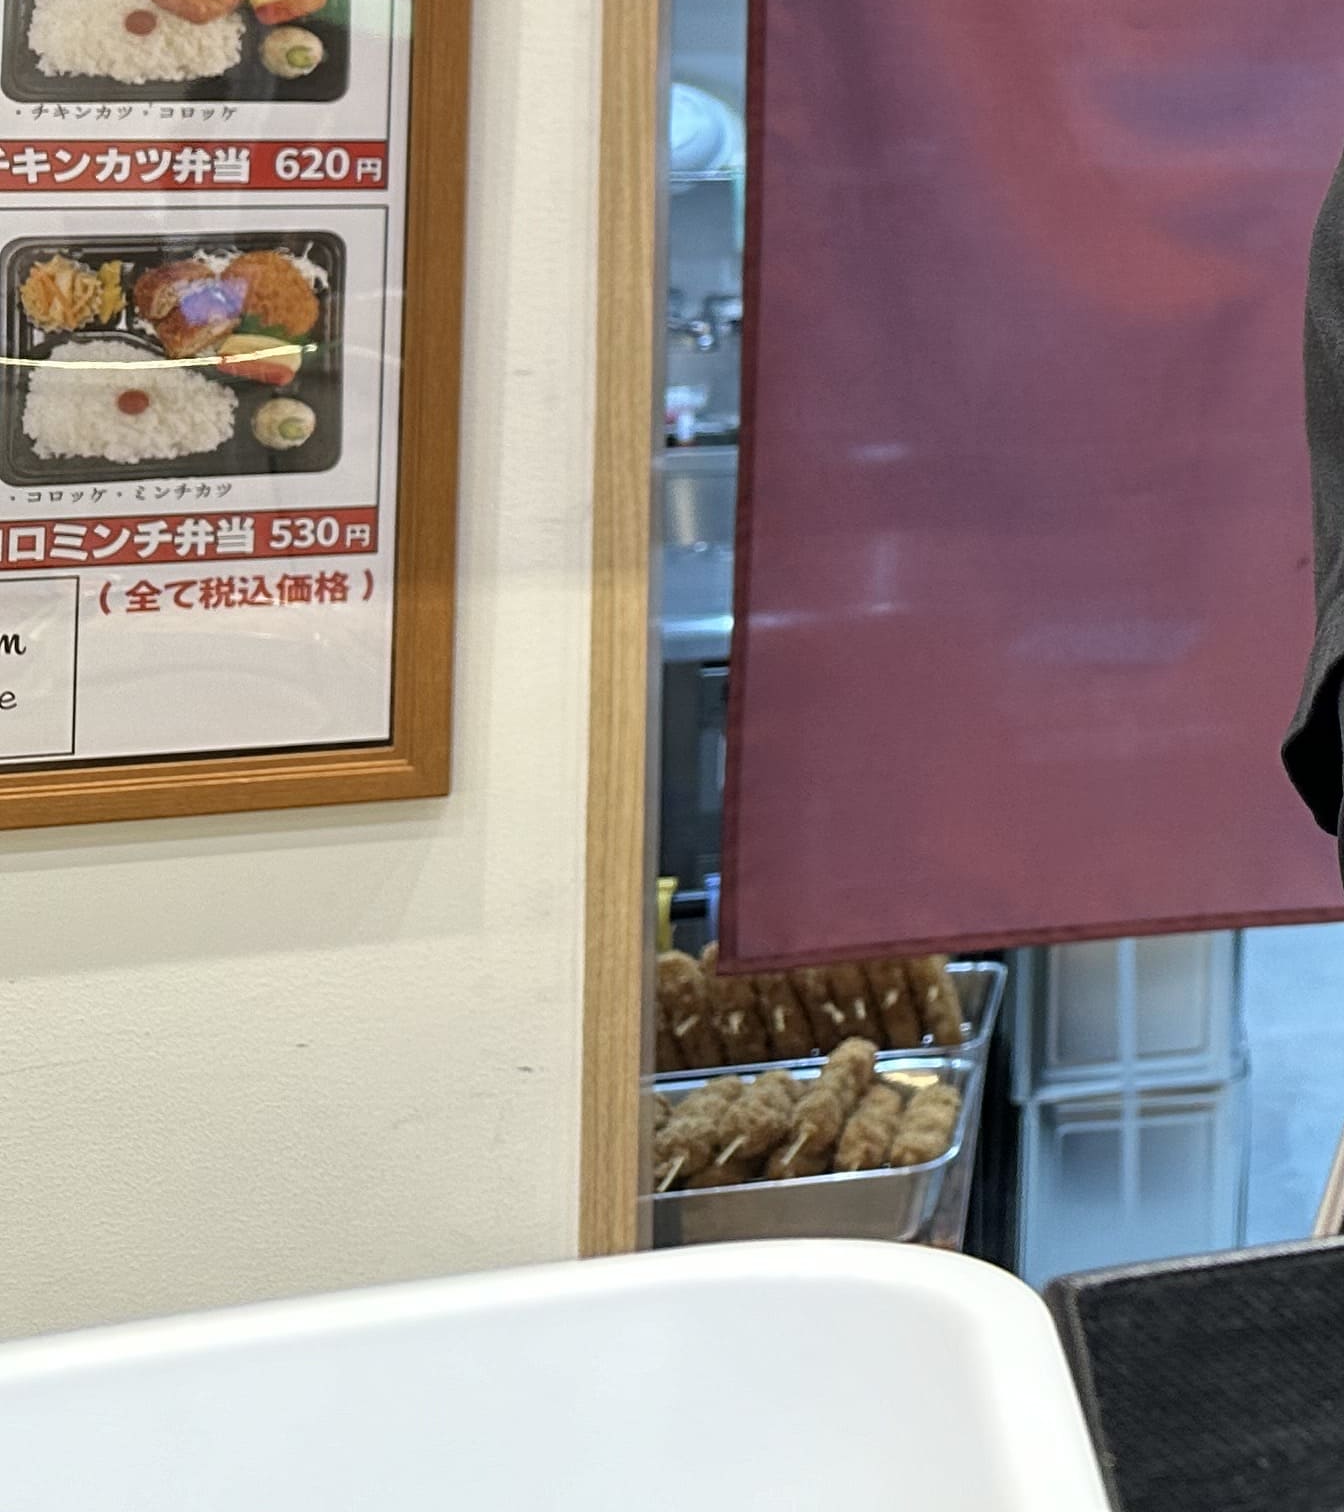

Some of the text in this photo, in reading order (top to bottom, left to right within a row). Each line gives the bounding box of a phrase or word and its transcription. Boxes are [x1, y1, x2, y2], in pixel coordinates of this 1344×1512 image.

[0, 146, 382, 184] キンカツ弁当 620円
[0, 516, 370, 562] ロミンチ弁当 530円
